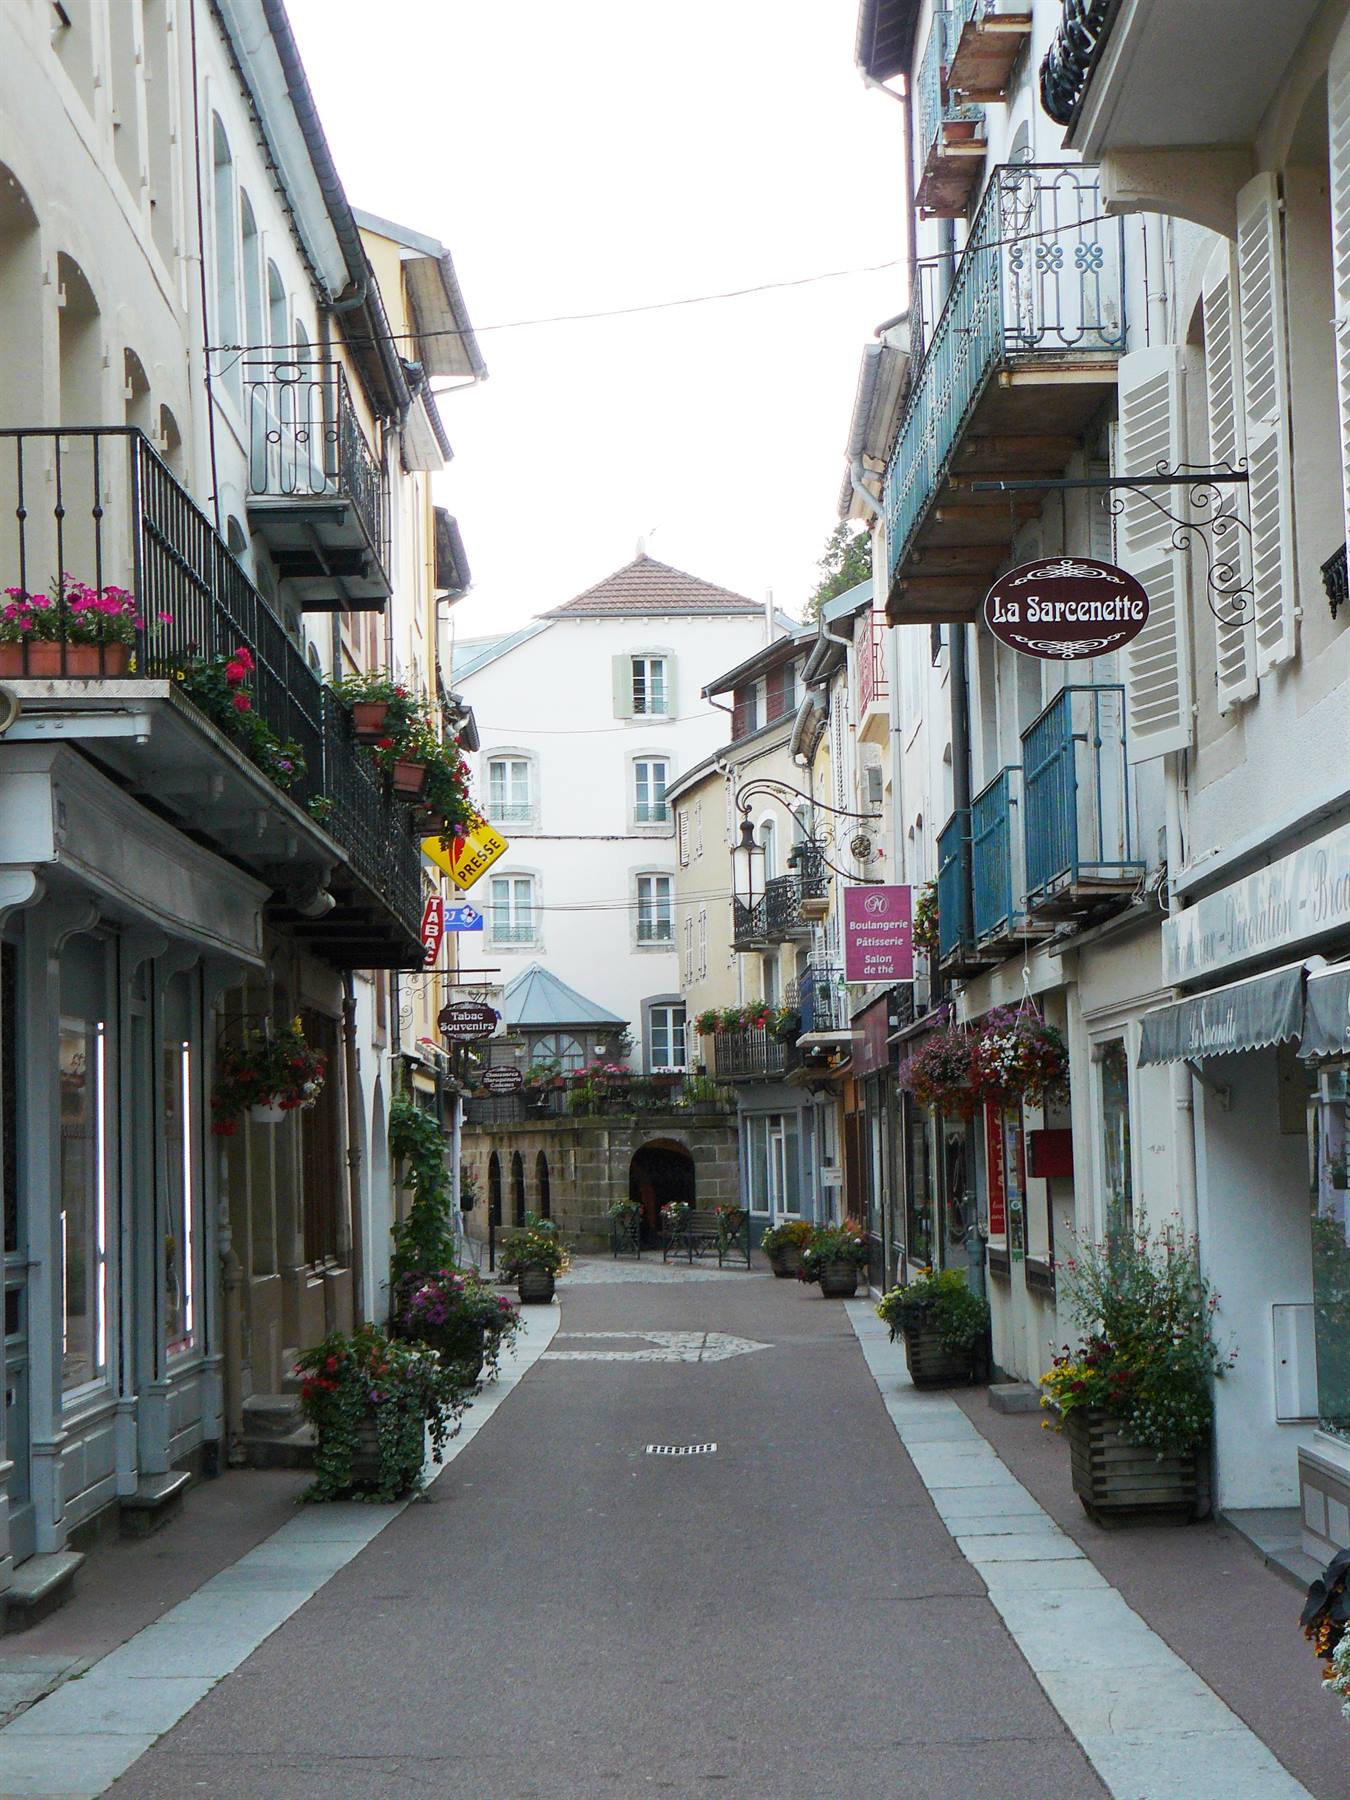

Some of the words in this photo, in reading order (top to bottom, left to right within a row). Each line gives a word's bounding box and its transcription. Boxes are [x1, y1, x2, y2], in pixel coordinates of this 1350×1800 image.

[992, 597, 1020, 623] La
[1026, 595, 1144, 623] Sarcenette
[458, 838, 501, 882] PRESSE
[424, 899, 440, 962] TABAC
[849, 920, 908, 931] Boulangerie
[856, 936, 904, 947] Pâtisserie
[864, 955, 892, 963] Salon
[864, 965, 876, 974] de
[877, 964, 894, 974] thé
[451, 1012, 484, 1021] Tabac
[440, 1022, 495, 1031] Souvenirs
